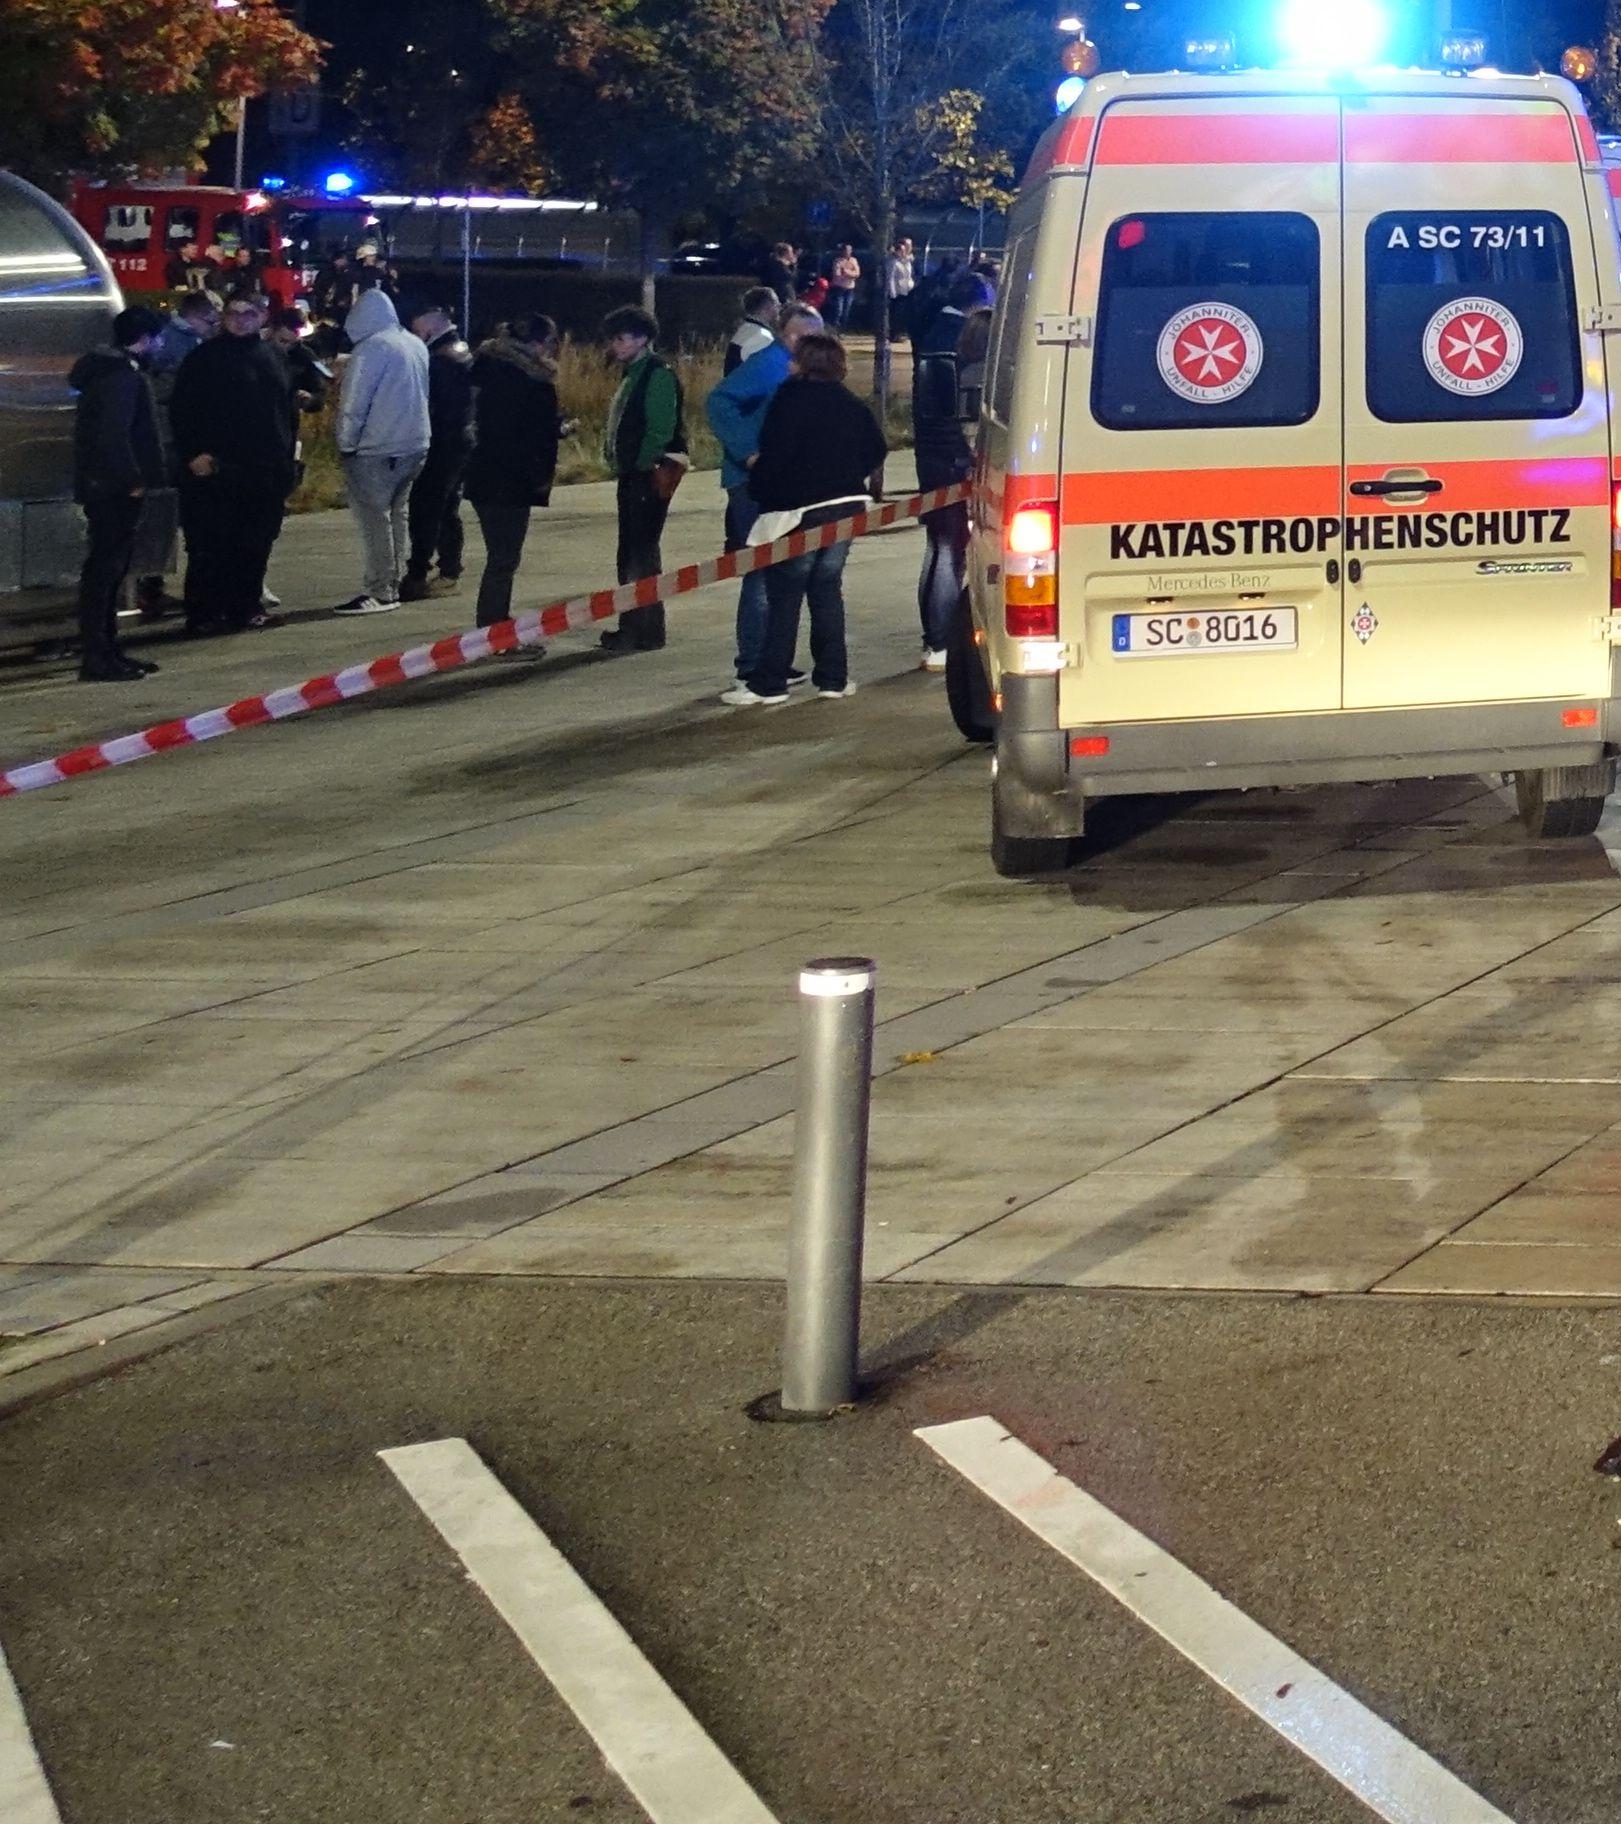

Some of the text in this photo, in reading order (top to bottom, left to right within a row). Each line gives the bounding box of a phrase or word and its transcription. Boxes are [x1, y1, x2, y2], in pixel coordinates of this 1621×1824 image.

[1387, 225, 1545, 251] A SC 73/11
[1166, 366, 1254, 398] UNFALL HILFE
[1432, 360, 1474, 390] UNFALL
[1485, 358, 1514, 387] HILFE
[1110, 509, 1571, 559] KATASTROPHENSCHUTZ
[1145, 618, 1184, 646] SC
[1205, 613, 1278, 643] 8016
